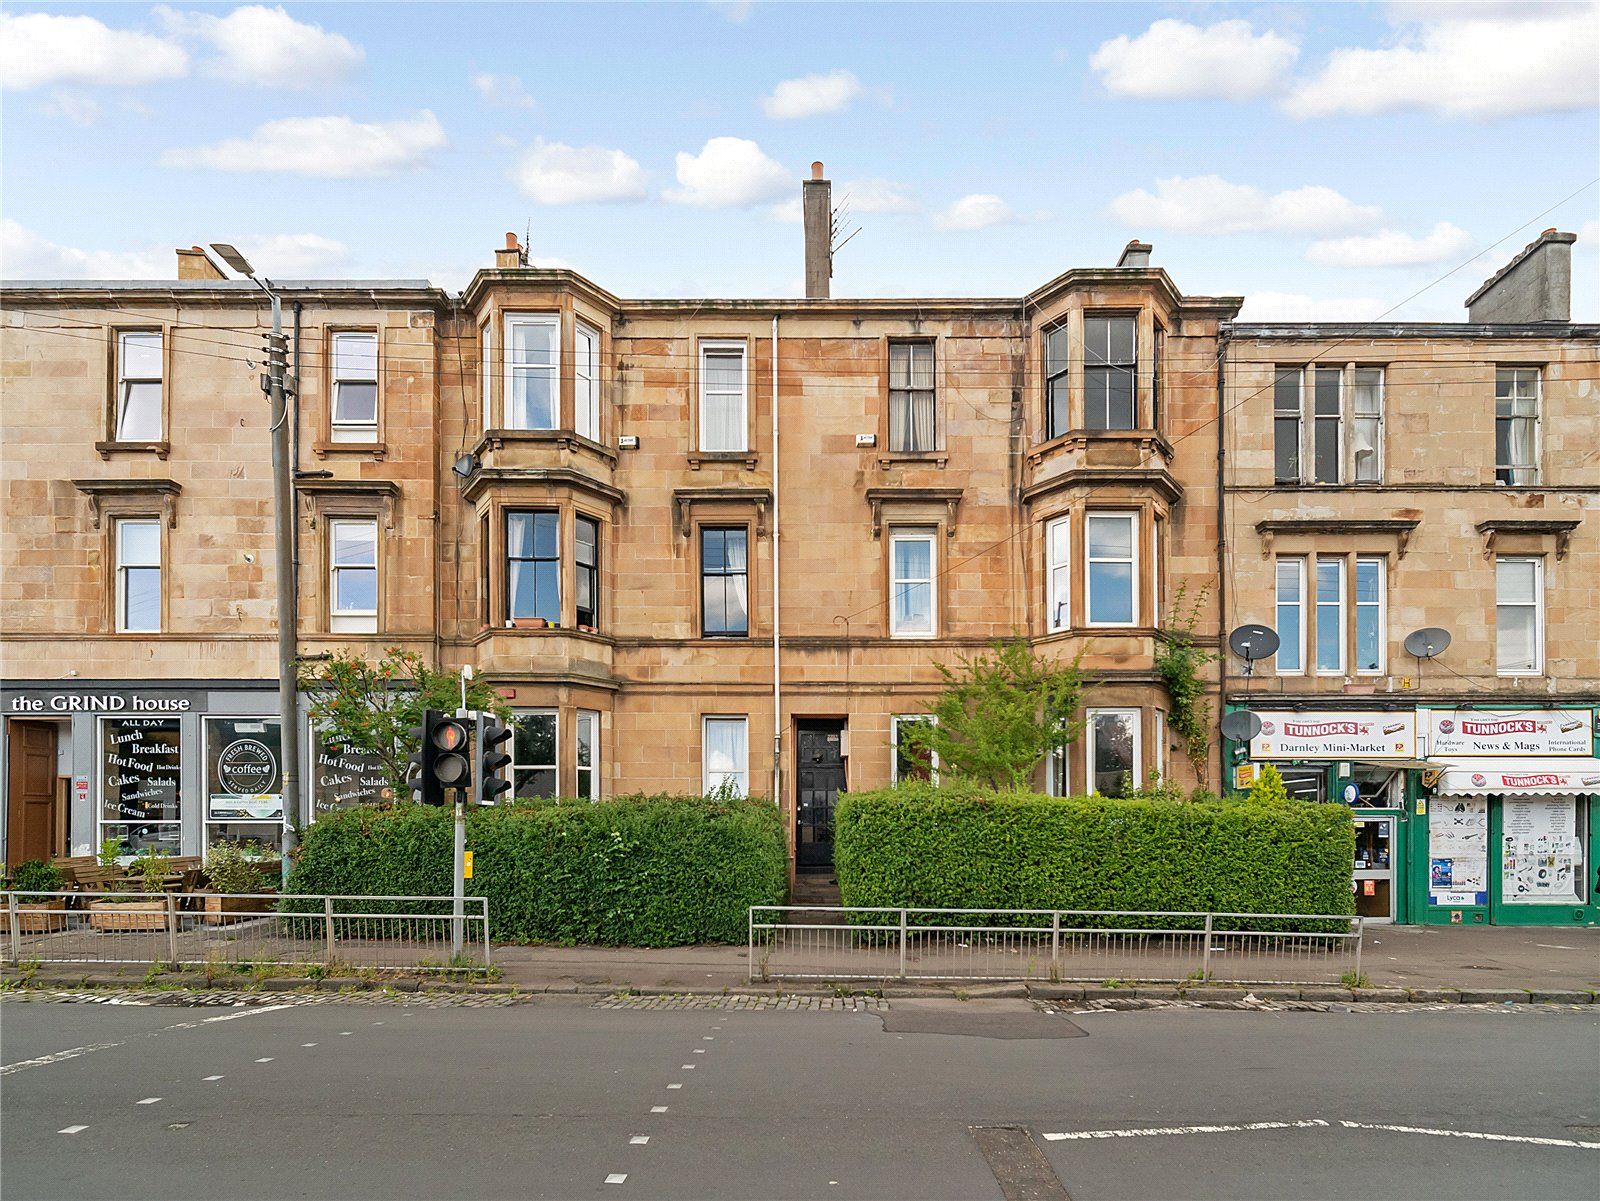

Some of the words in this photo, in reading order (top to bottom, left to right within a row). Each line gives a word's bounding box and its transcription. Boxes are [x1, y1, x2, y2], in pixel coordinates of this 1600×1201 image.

[12, 696, 44, 711] the
[50, 695, 126, 711] GRIND
[132, 696, 191, 711] house
[122, 719, 141, 727] ALL
[143, 719, 165, 727] DAY
[1286, 722, 1356, 736] TUNNOCK'S
[1465, 721, 1534, 735] TUNNOCK'S
[110, 729, 143, 745] Lunch
[132, 743, 179, 754] Breakfast
[225, 744, 243, 762] FRESH
[244, 744, 268, 762] BREWED
[1280, 743, 1320, 753] Darnley
[1323, 743, 1386, 752] Mini-Market
[1473, 741, 1500, 751] News
[1502, 741, 1511, 751] &
[1514, 741, 1541, 753] Mags
[108, 753, 128, 767] Hot
[127, 757, 154, 772] Food
[231, 763, 262, 774] coffee
[319, 753, 339, 767] Hot
[338, 758, 365, 773] Food
[108, 774, 140, 787] Cakes
[147, 776, 177, 787] Salads
[228, 780, 249, 793] SERVED
[250, 780, 266, 794] DAILY
[320, 774, 353, 787] Cakes
[359, 776, 389, 786] Salads
[1504, 774, 1558, 787] TUNNOCK'S
[121, 788, 163, 801] Sandwiches
[333, 787, 376, 800] Sandwiches
[104, 799, 117, 811] Ice
[117, 803, 146, 818] Cream
[316, 799, 329, 810] Ice
